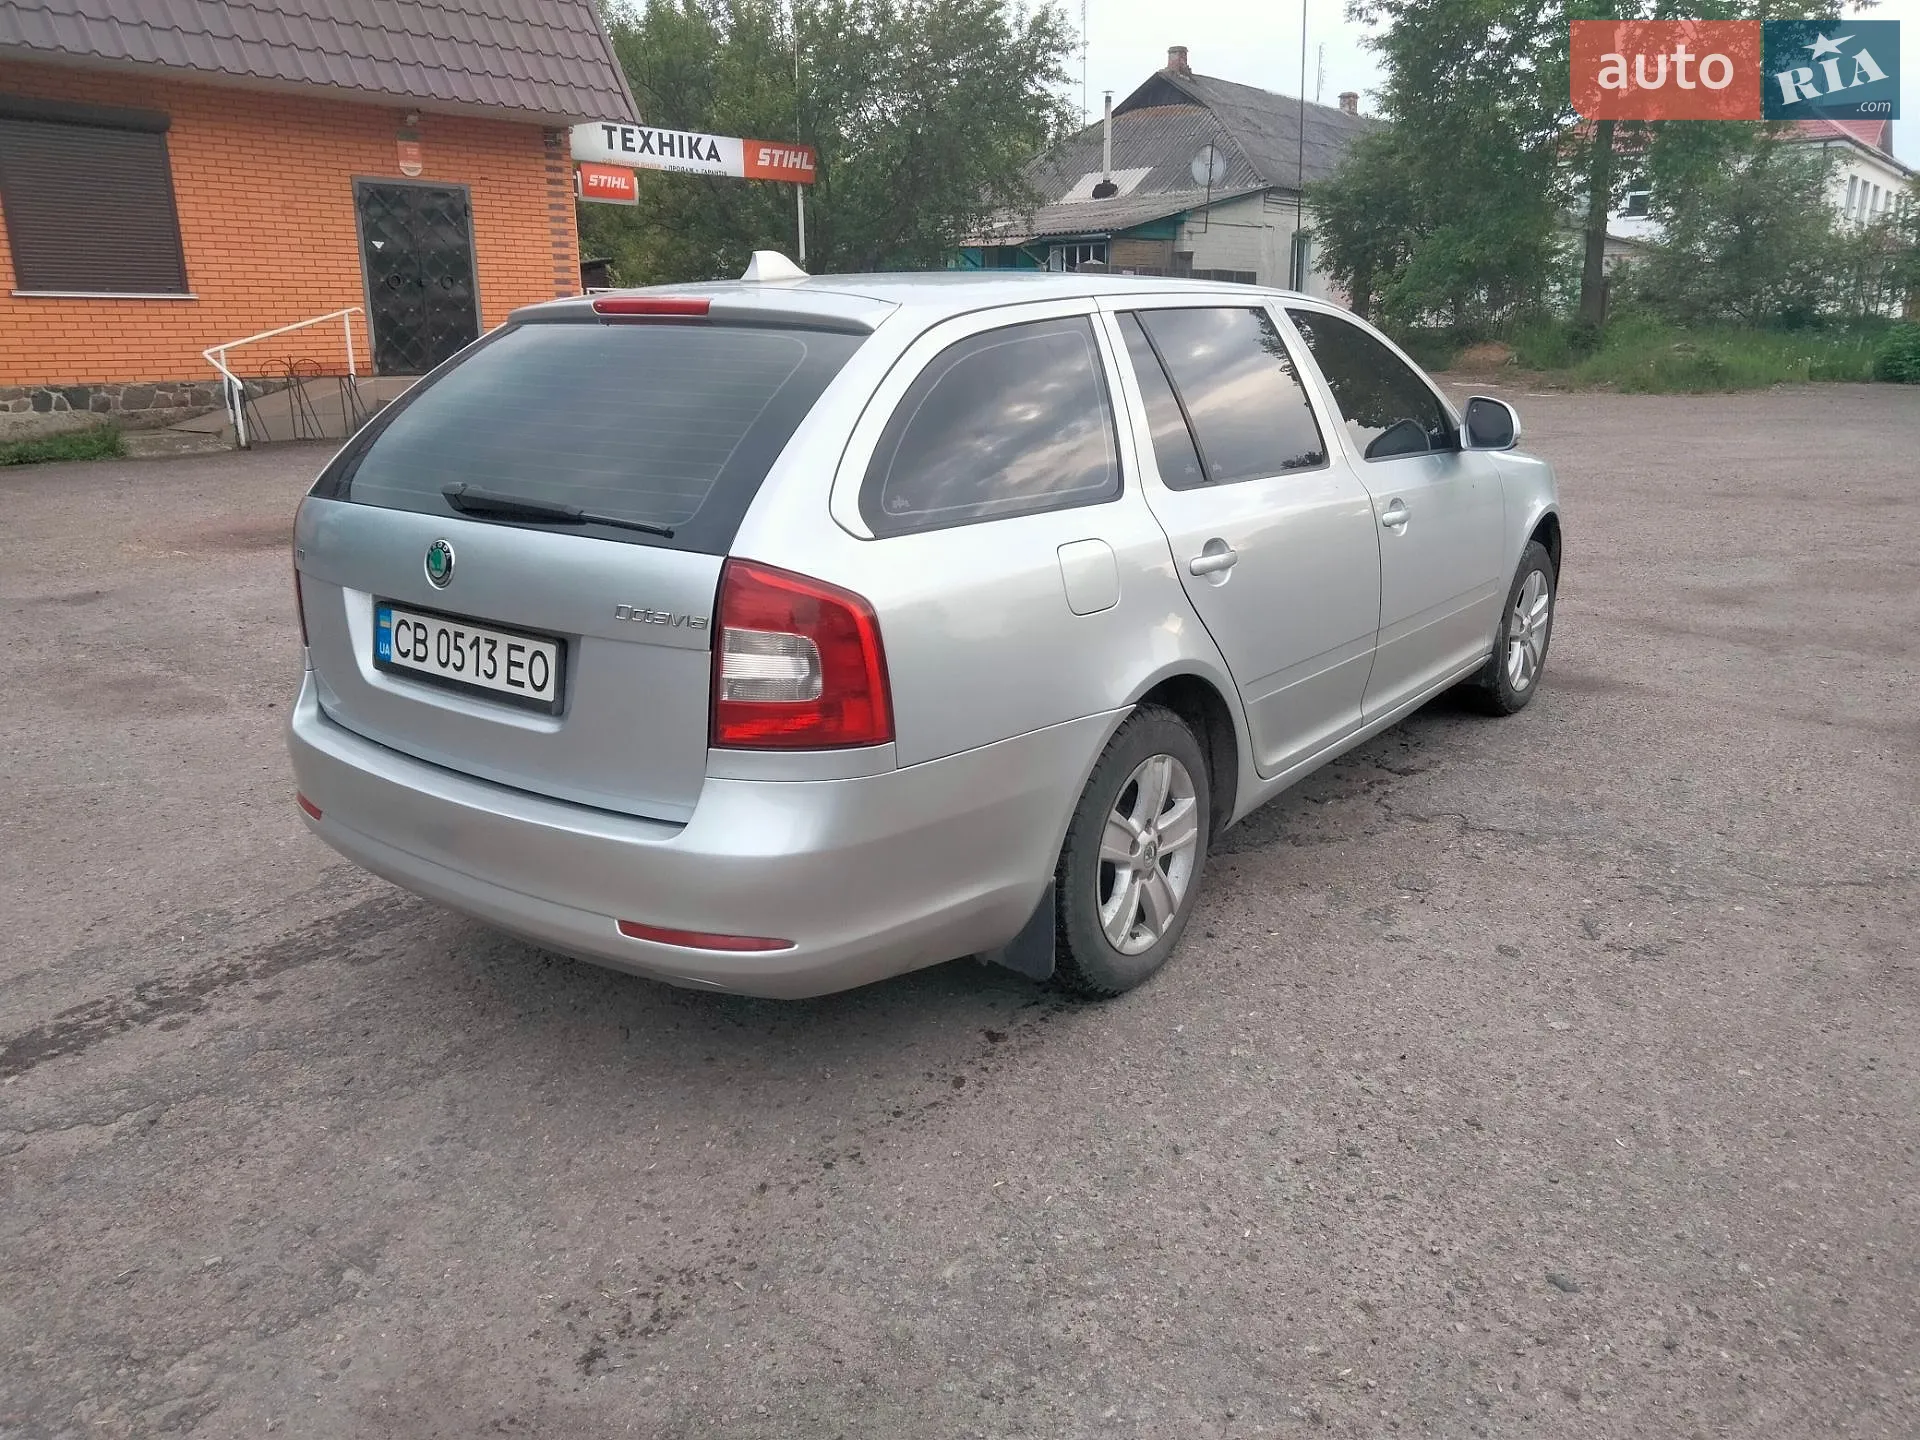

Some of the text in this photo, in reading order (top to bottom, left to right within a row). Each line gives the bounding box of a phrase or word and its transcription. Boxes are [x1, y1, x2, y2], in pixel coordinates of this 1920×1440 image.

[602, 124, 722, 163] ТЕХНІКА
[757, 148, 814, 170] STIHL
[588, 174, 630, 190] STIHL
[615, 603, 709, 630] Octavia
[379, 641, 391, 656] UA
[394, 618, 550, 693] CB 0513 EO
